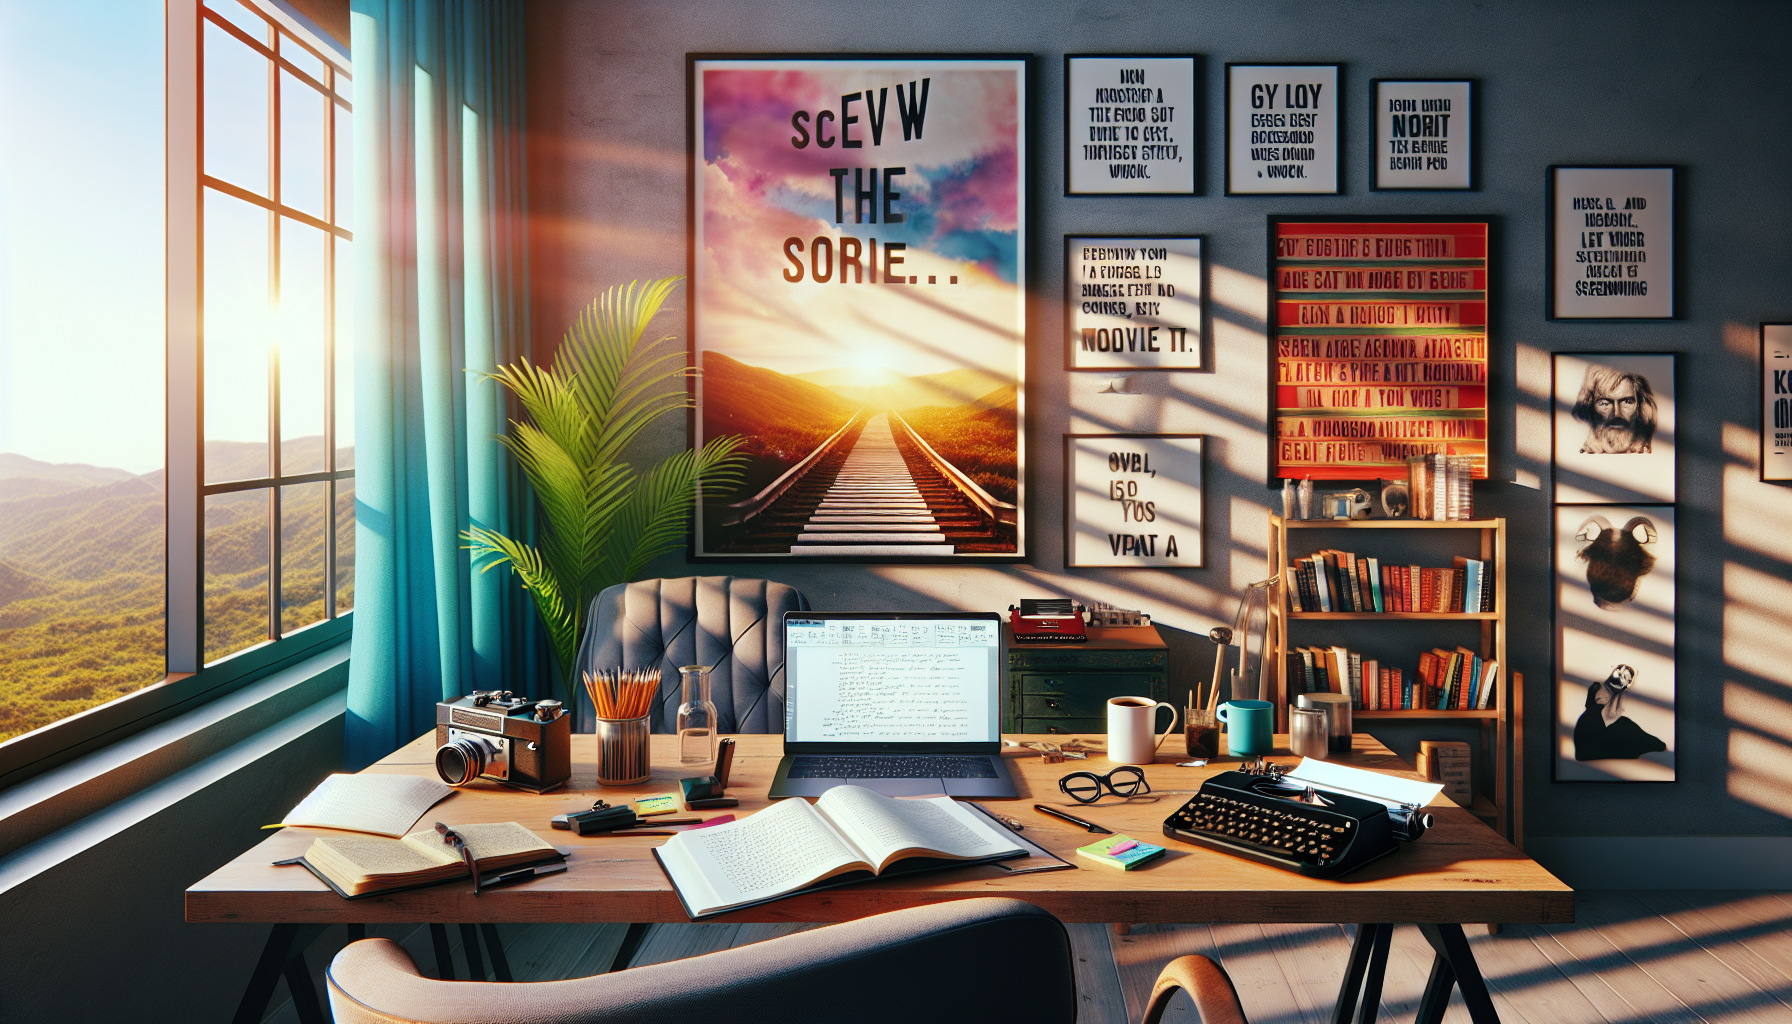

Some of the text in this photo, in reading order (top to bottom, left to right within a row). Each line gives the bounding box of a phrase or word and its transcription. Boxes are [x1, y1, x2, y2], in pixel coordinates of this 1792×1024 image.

[1251, 83, 1322, 109] GY LOY
[829, 166, 906, 224] THE
[783, 236, 958, 284] SORIE...
[1165, 534, 1179, 558] A
